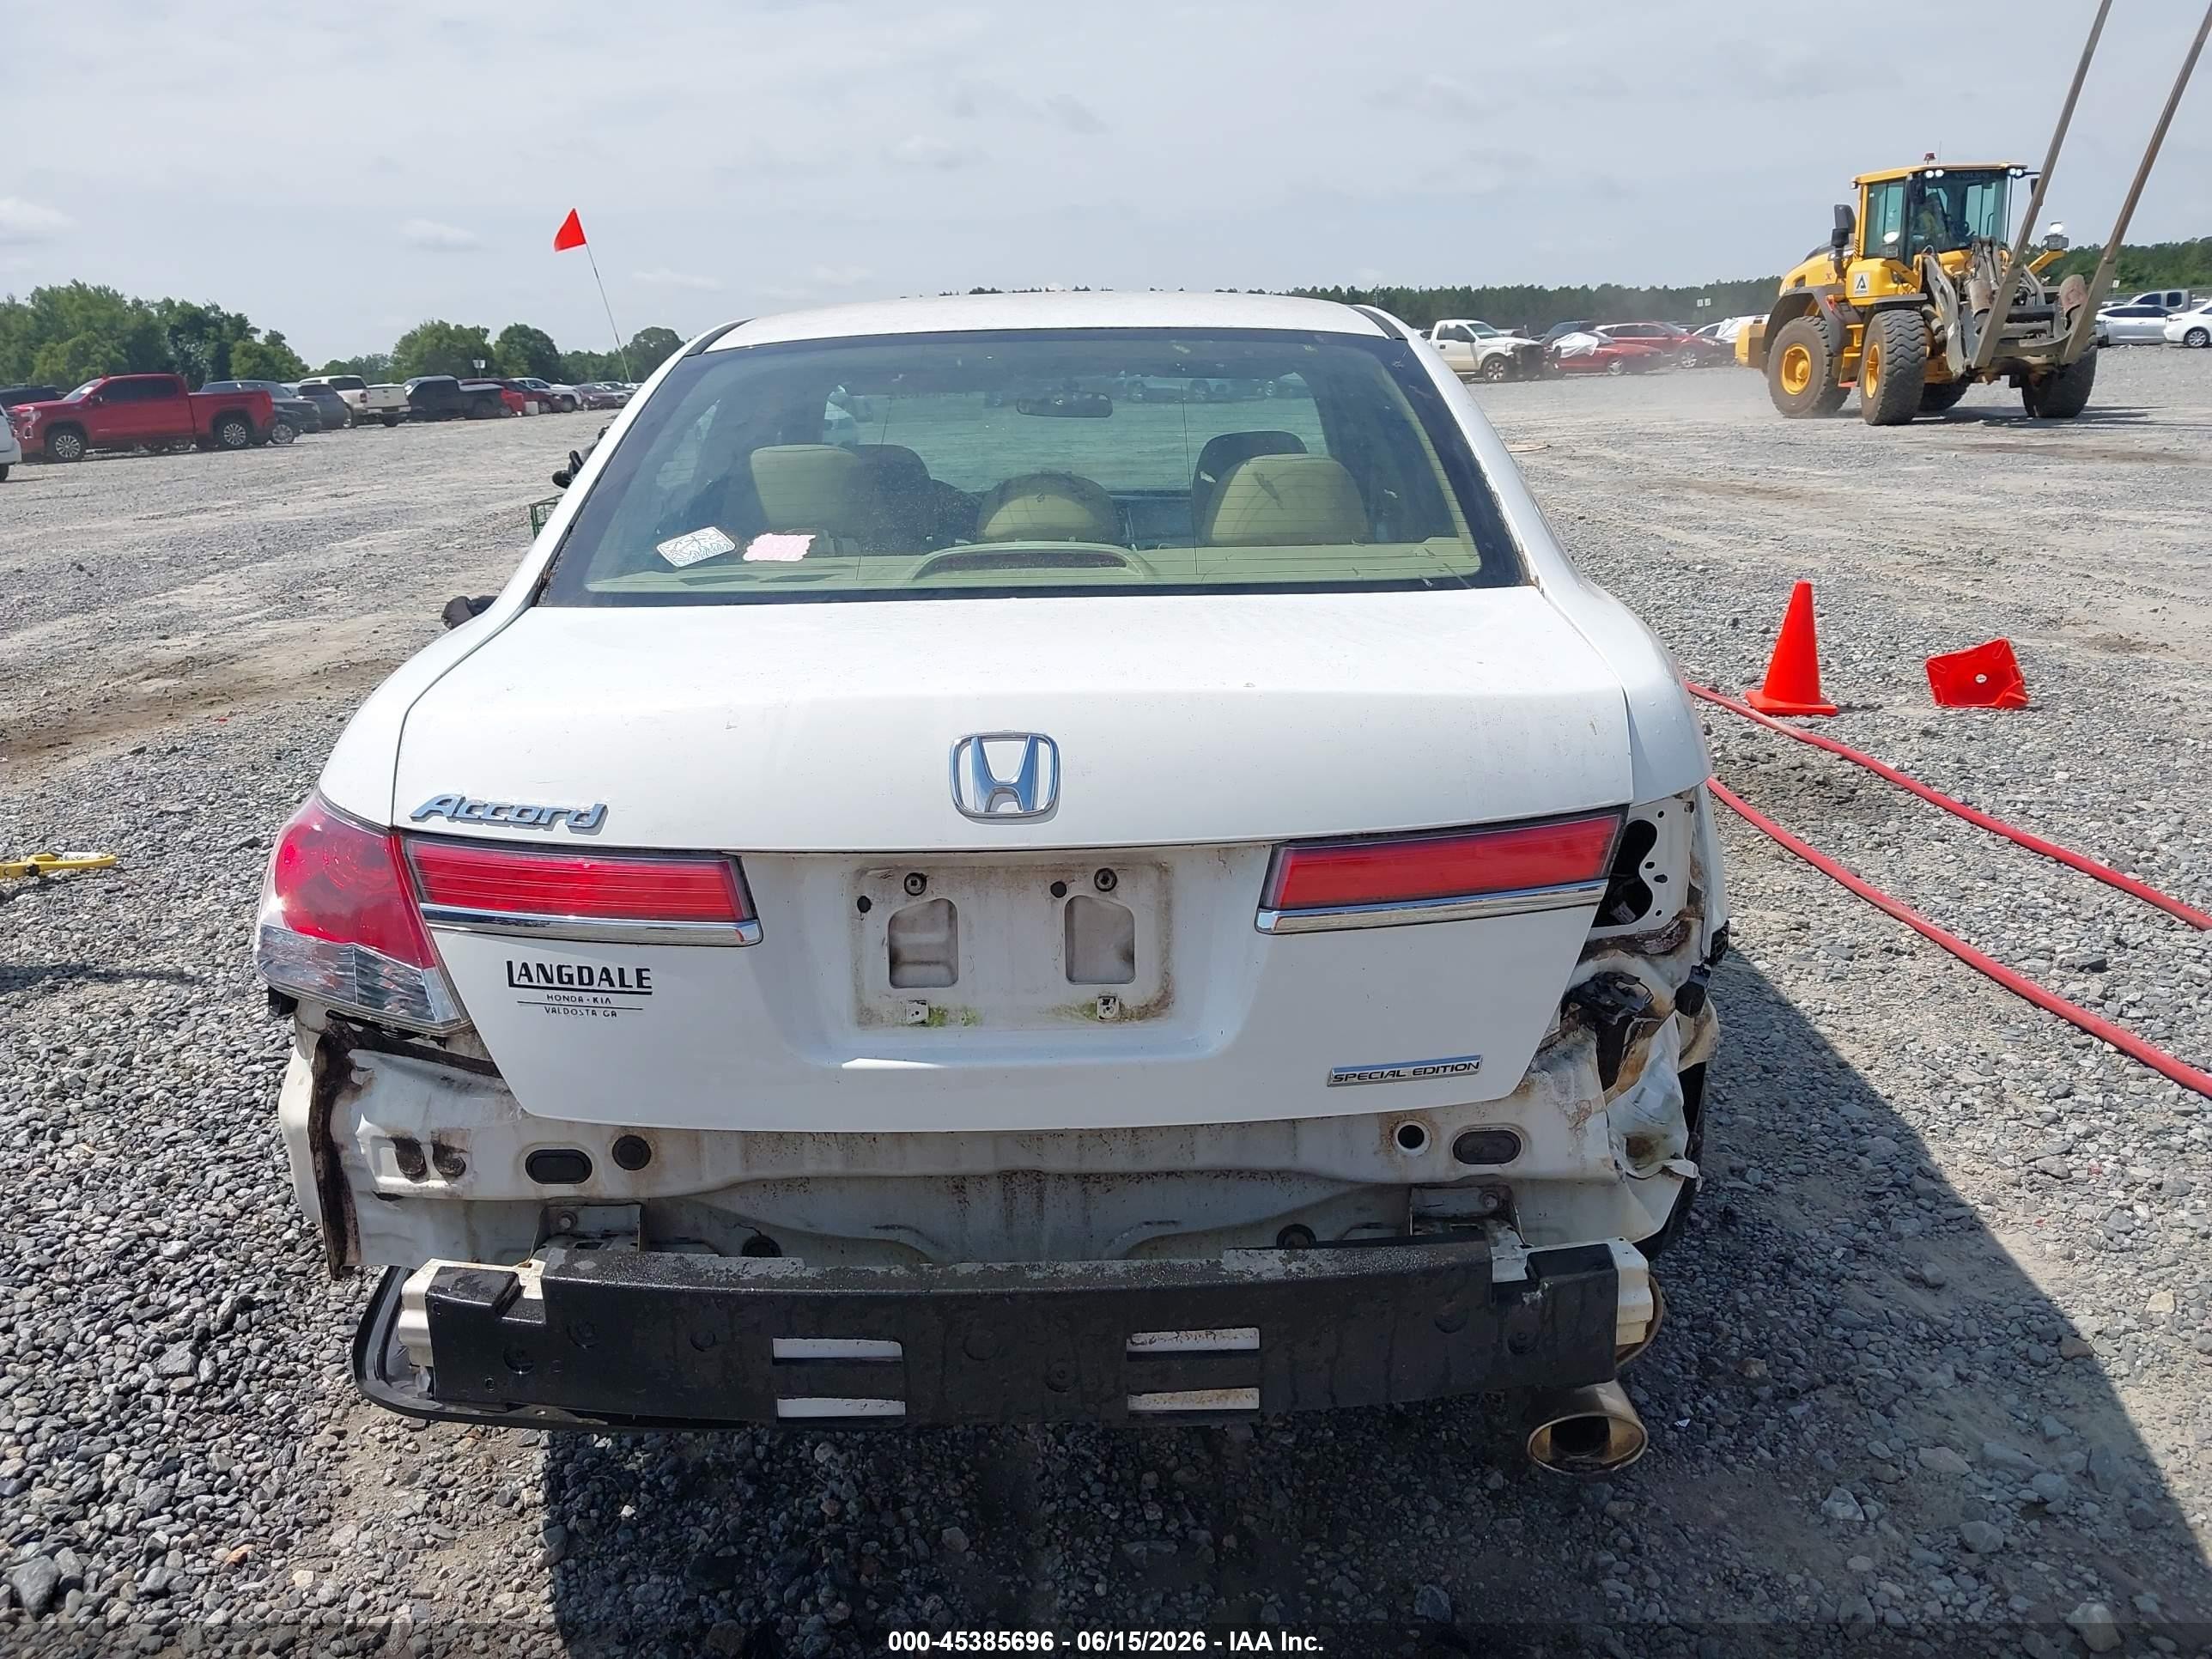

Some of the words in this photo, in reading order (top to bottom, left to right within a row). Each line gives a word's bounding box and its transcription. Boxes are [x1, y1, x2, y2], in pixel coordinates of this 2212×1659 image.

[410, 793, 609, 835] Accord
[506, 960, 653, 993] LANGDALE
[544, 1006, 598, 1017] VALDOSTA
[602, 1009, 617, 1018] GA
[1333, 1069, 1407, 1082] SPECIAL
[1413, 1061, 1480, 1076] EDITION
